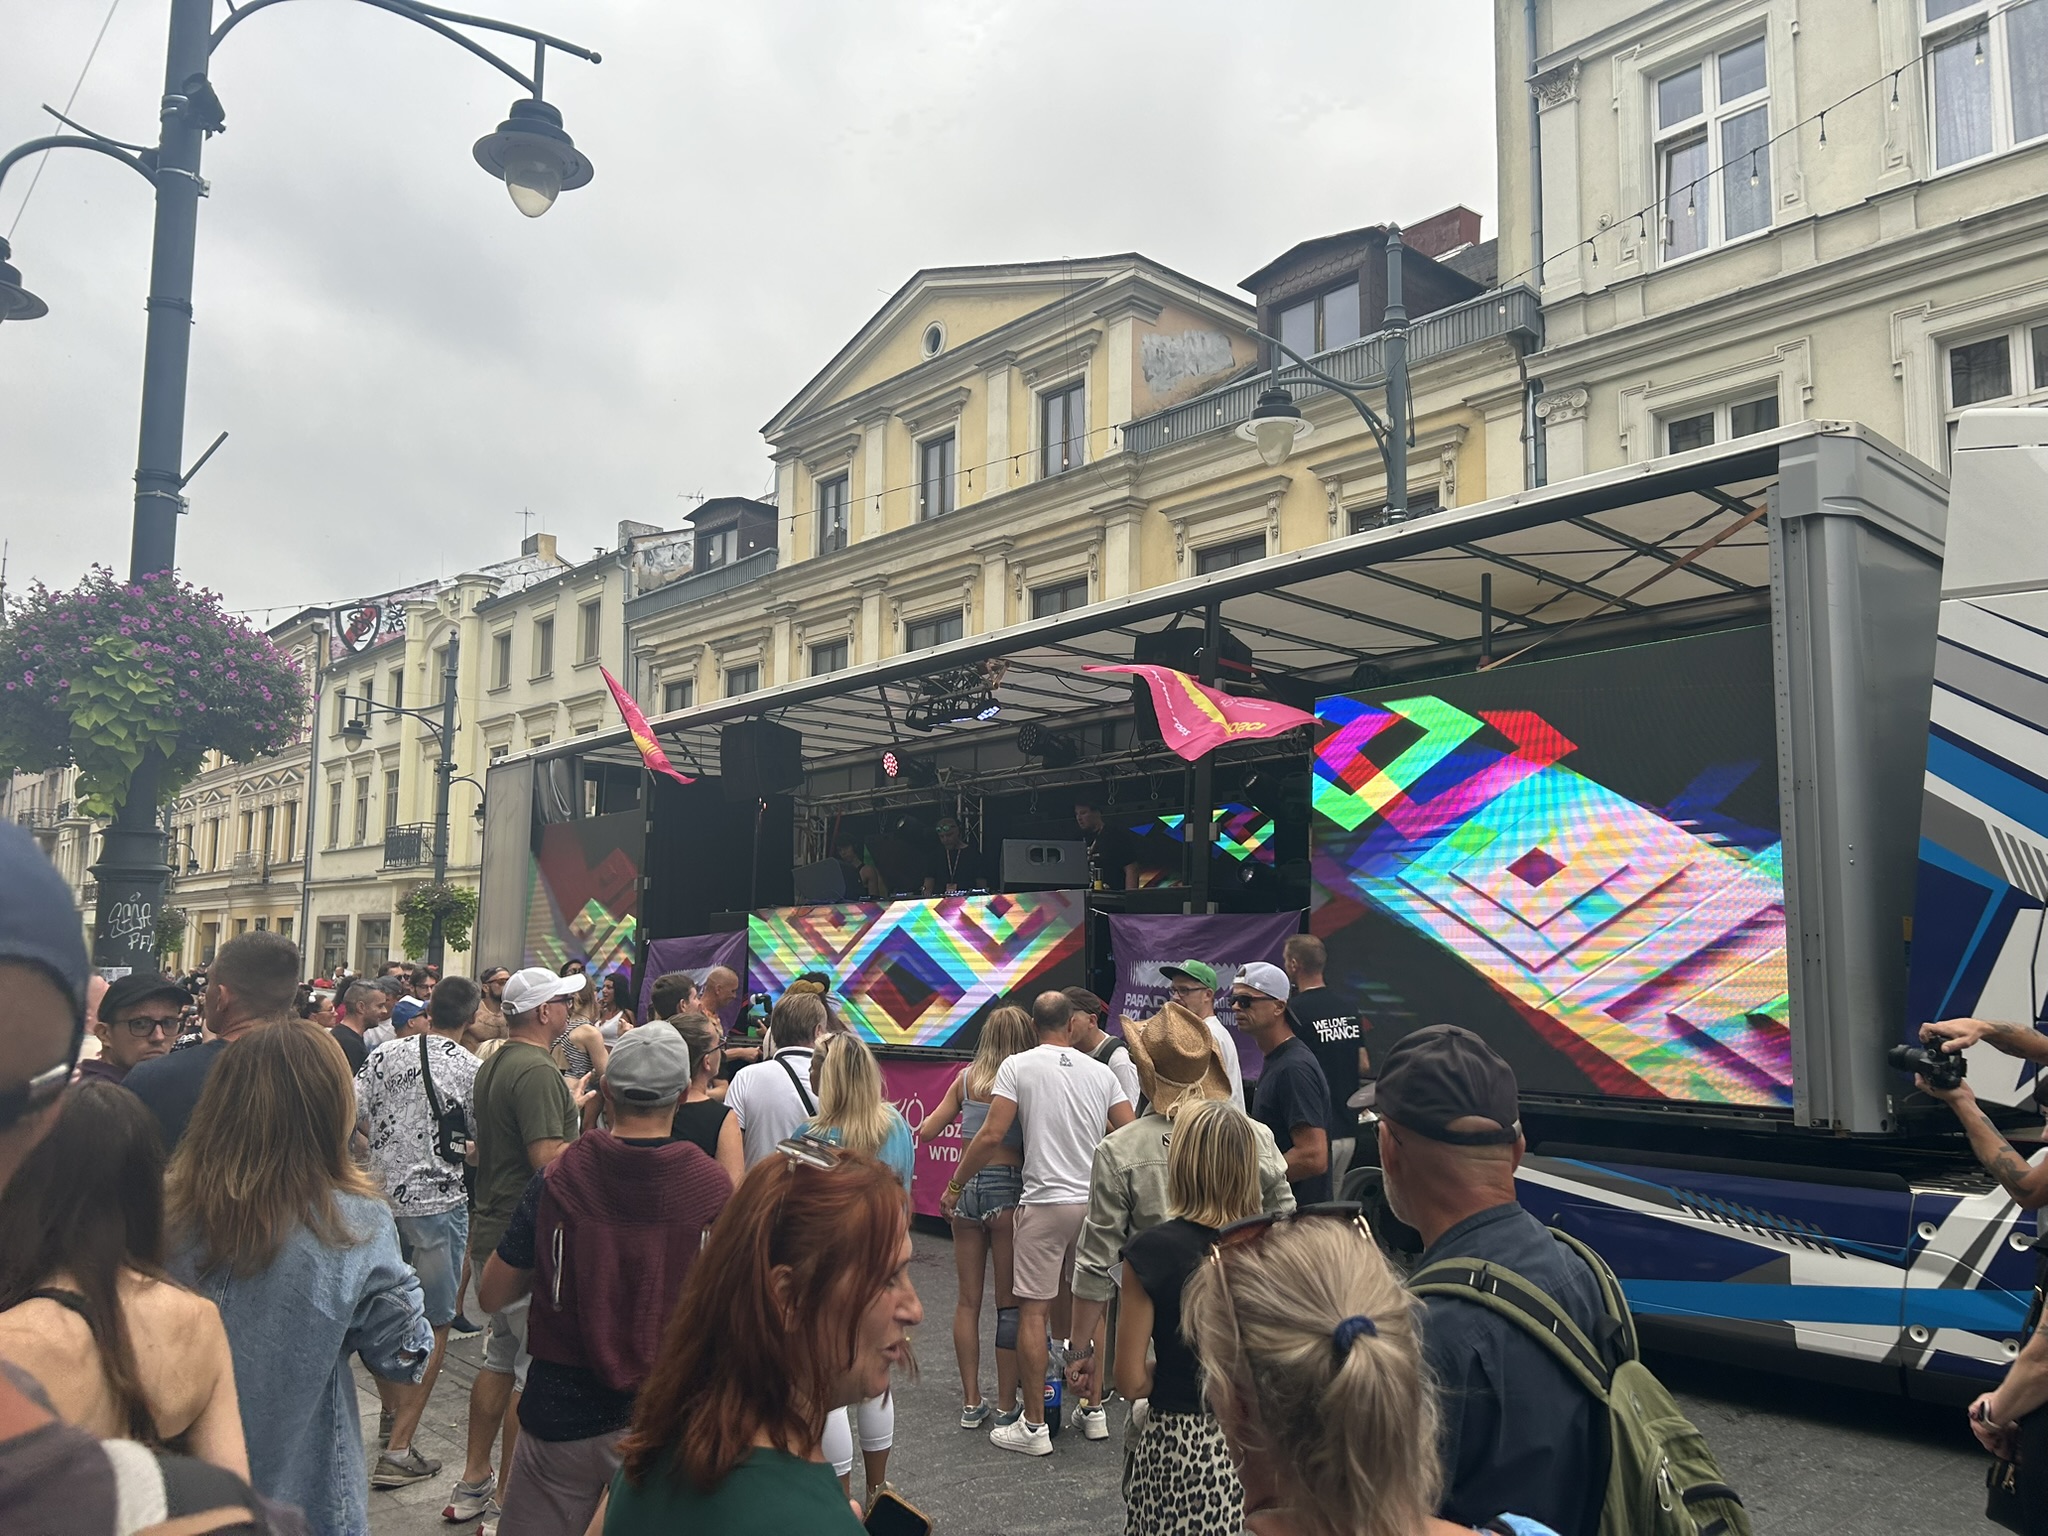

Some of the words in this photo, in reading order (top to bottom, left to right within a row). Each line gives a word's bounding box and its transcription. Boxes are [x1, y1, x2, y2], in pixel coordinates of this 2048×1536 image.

[1125, 993, 1168, 1009] PARAD
[1312, 1019, 1328, 1031] WE
[1328, 1016, 1348, 1029] LOVE
[1317, 1025, 1360, 1043] TRANCE
